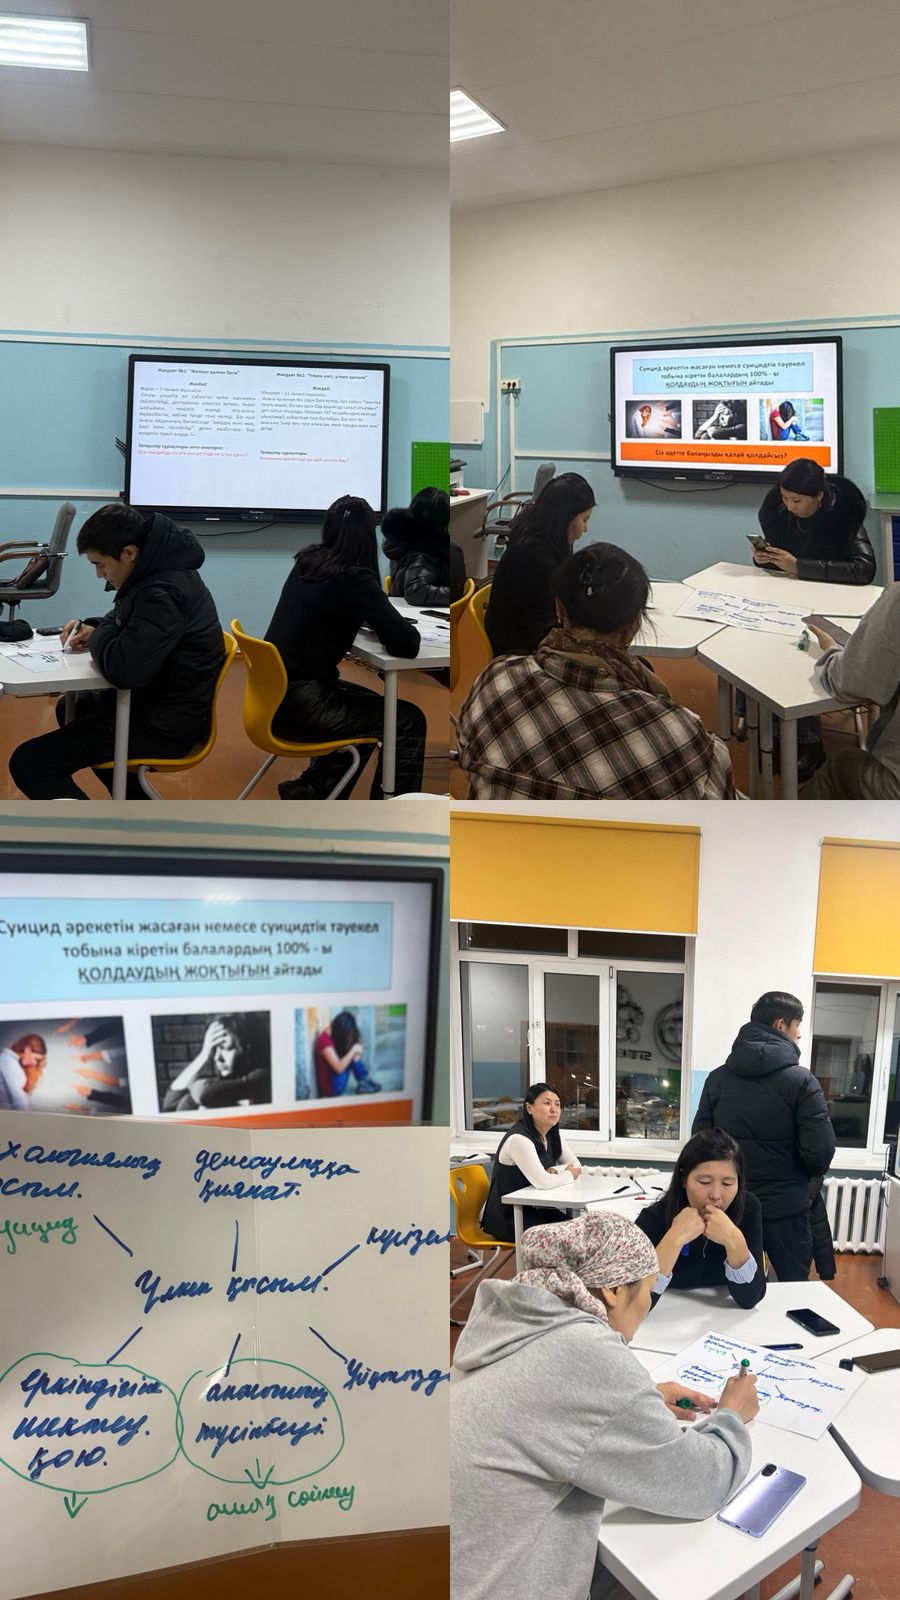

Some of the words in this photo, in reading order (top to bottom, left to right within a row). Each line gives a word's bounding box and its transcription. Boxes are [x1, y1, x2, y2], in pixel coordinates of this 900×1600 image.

[0, 919, 62, 937] Суицид
[66, 918, 134, 937] әрекетін
[139, 920, 200, 934] жасаған
[205, 921, 257, 934] немесе
[260, 919, 327, 937] суицидтік
[330, 920, 380, 936] тәуекел
[63, 944, 122, 958] тобына
[127, 942, 179, 961] кіретін
[183, 941, 273, 959] балалардың
[276, 942, 311, 956] 100%
[322, 945, 333, 955] ы
[78, 965, 181, 983] ҚОЛДАУДЫҢ
[184, 962, 271, 981] ЖОҚТЫҒЫН
[274, 961, 323, 978] айтады
